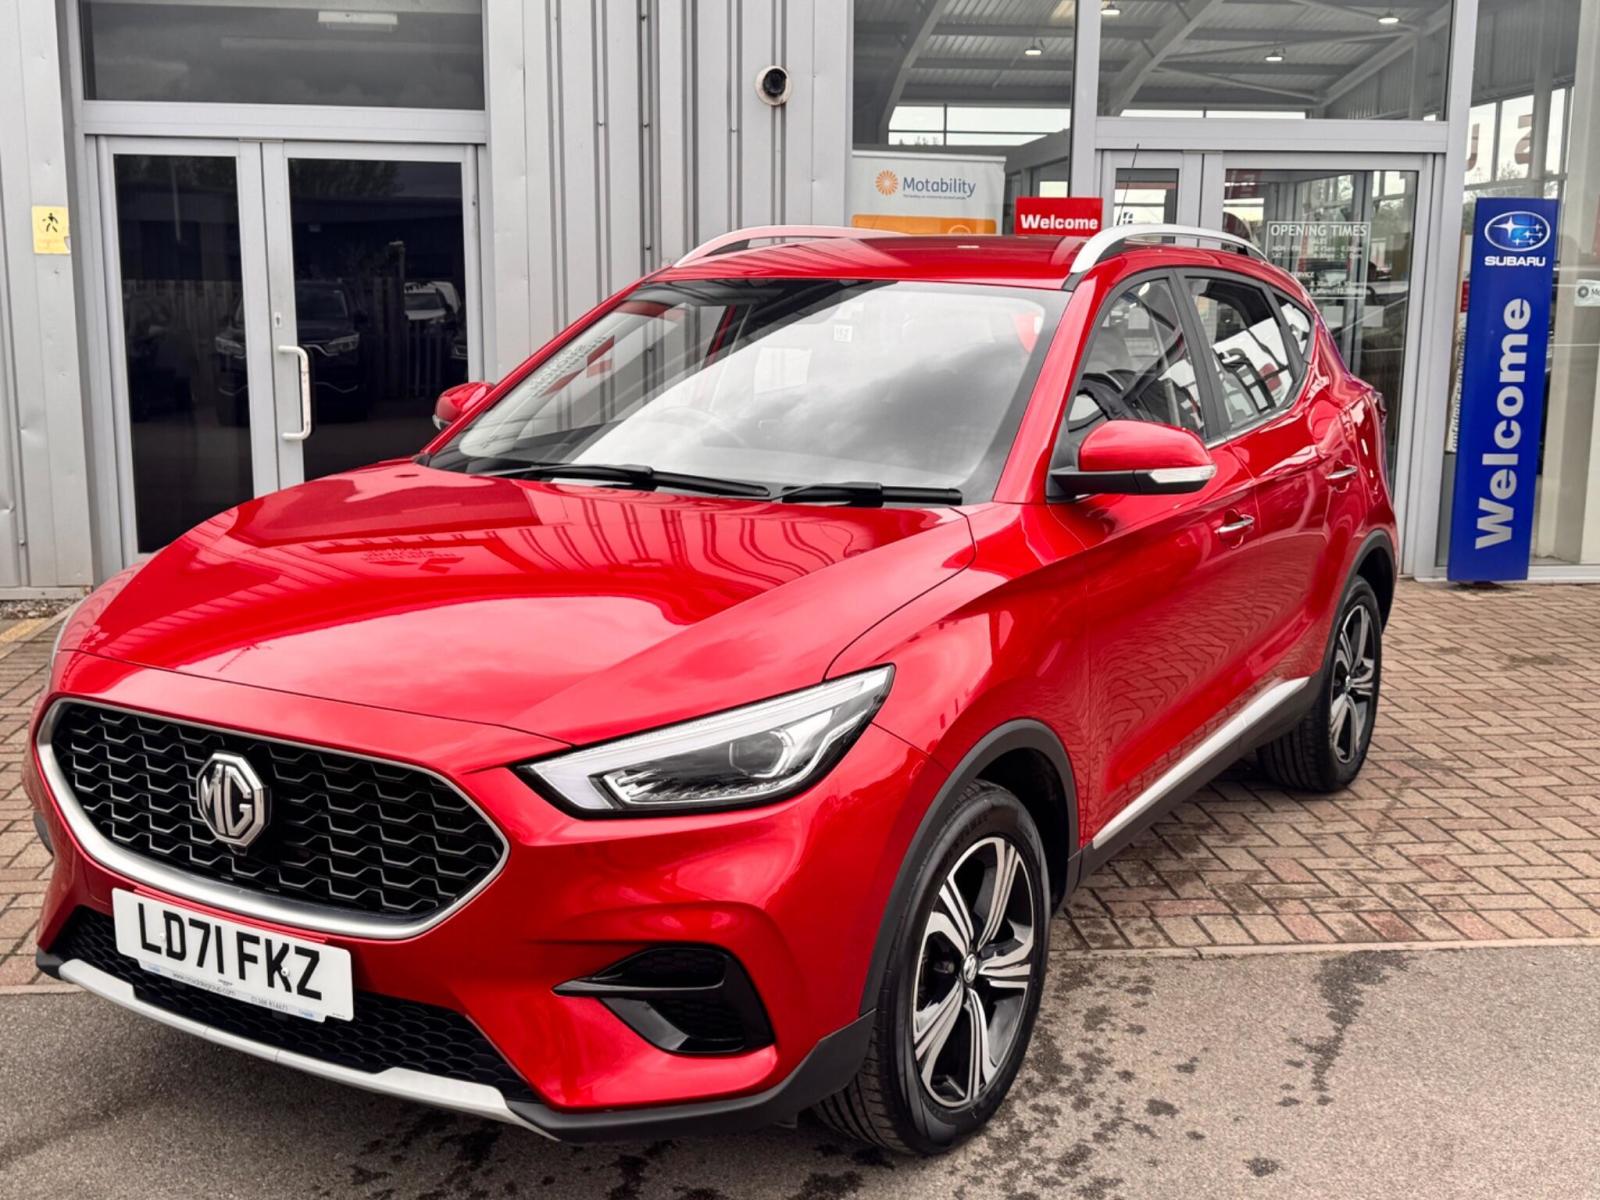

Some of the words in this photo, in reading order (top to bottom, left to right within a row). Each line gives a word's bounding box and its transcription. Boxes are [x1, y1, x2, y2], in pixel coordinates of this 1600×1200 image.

[902, 176, 977, 198] Motability
[1020, 213, 1099, 230] Welcome
[1270, 224, 1328, 237] OPENING
[1330, 224, 1368, 237] TIMES
[1484, 255, 1547, 268] SUBARU
[1474, 297, 1532, 550] Welcome
[201, 763, 254, 837] MG
[137, 902, 225, 975] LD71
[235, 930, 323, 1002] FKZ
